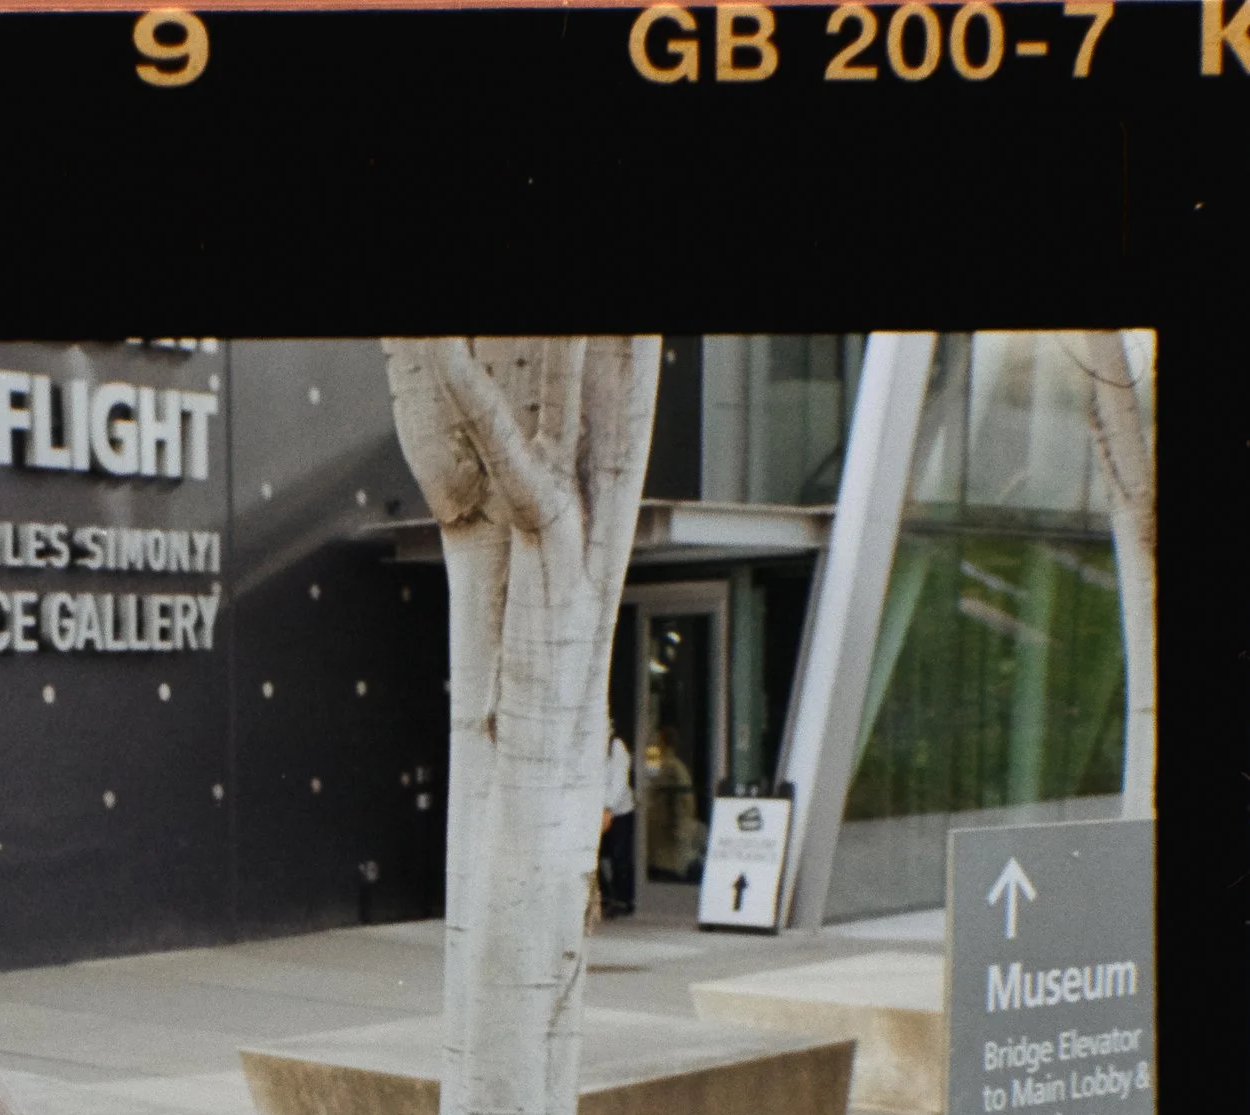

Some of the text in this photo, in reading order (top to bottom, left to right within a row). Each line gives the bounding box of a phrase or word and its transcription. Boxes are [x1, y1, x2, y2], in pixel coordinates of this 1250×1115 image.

[132, 7, 209, 87] 9
[628, 2, 1115, 83] GB 200-7
[1200, 0, 1250, 76] K
[73, 524, 221, 574] SIMONYI
[41, 591, 220, 652] GALLERY
[985, 960, 1138, 1014] Museum
[983, 1028, 1143, 1074] Bridge Elevator
[981, 1059, 1150, 1113] to Main Lobby &
